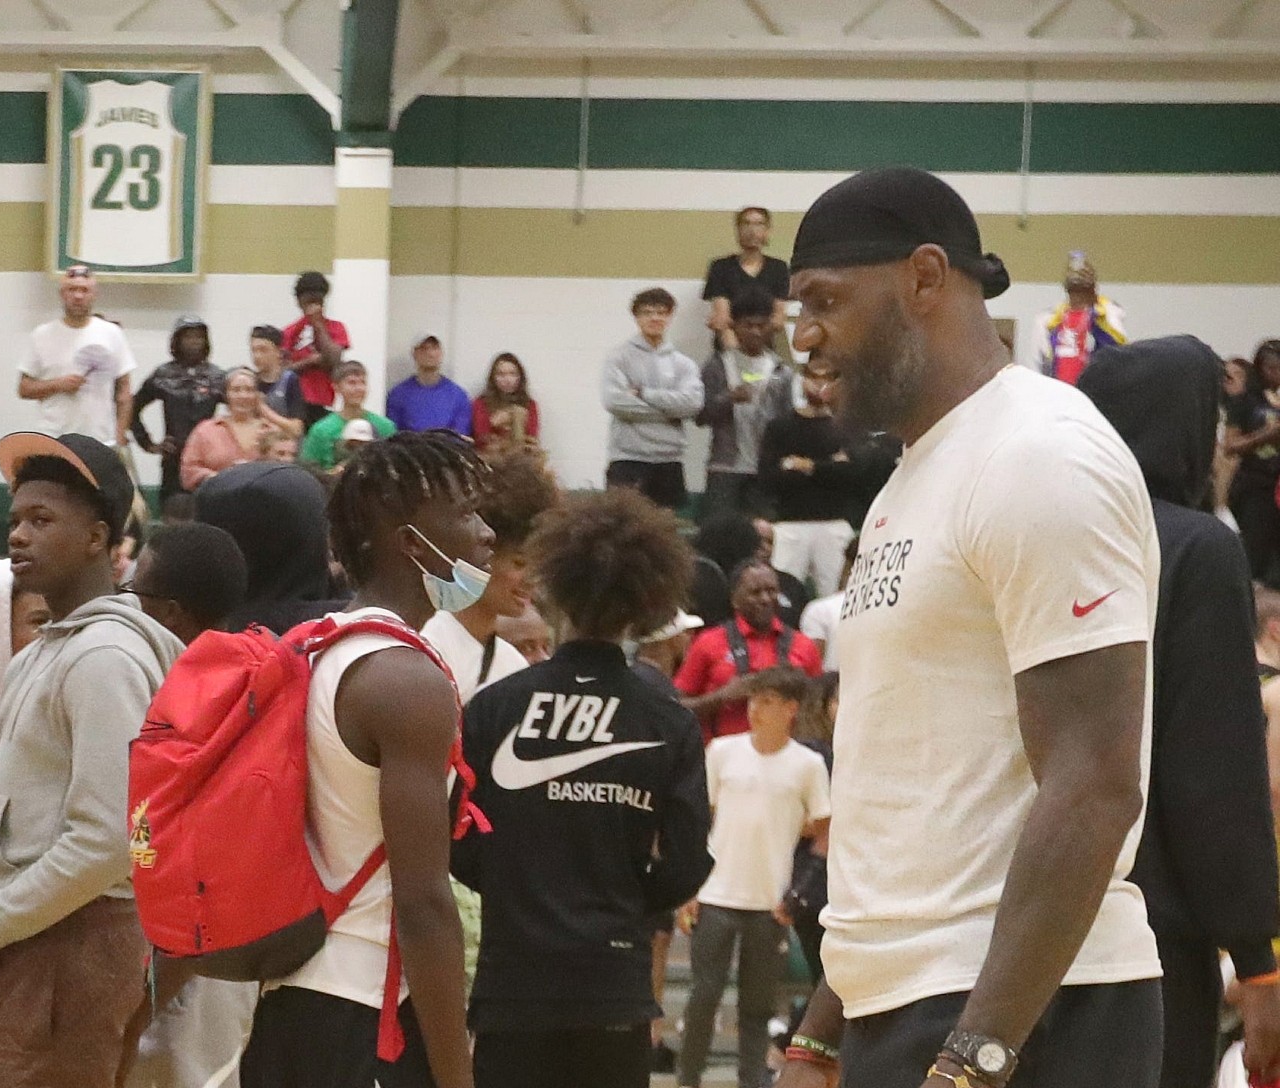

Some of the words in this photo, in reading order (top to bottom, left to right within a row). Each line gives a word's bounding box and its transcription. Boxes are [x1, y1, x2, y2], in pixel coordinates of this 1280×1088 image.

[96, 107, 159, 129] JAMES
[91, 144, 161, 211] 23
[876, 539, 913, 574] FOR
[518, 691, 620, 743] EYBL
[547, 780, 654, 812] BASKETBALL
